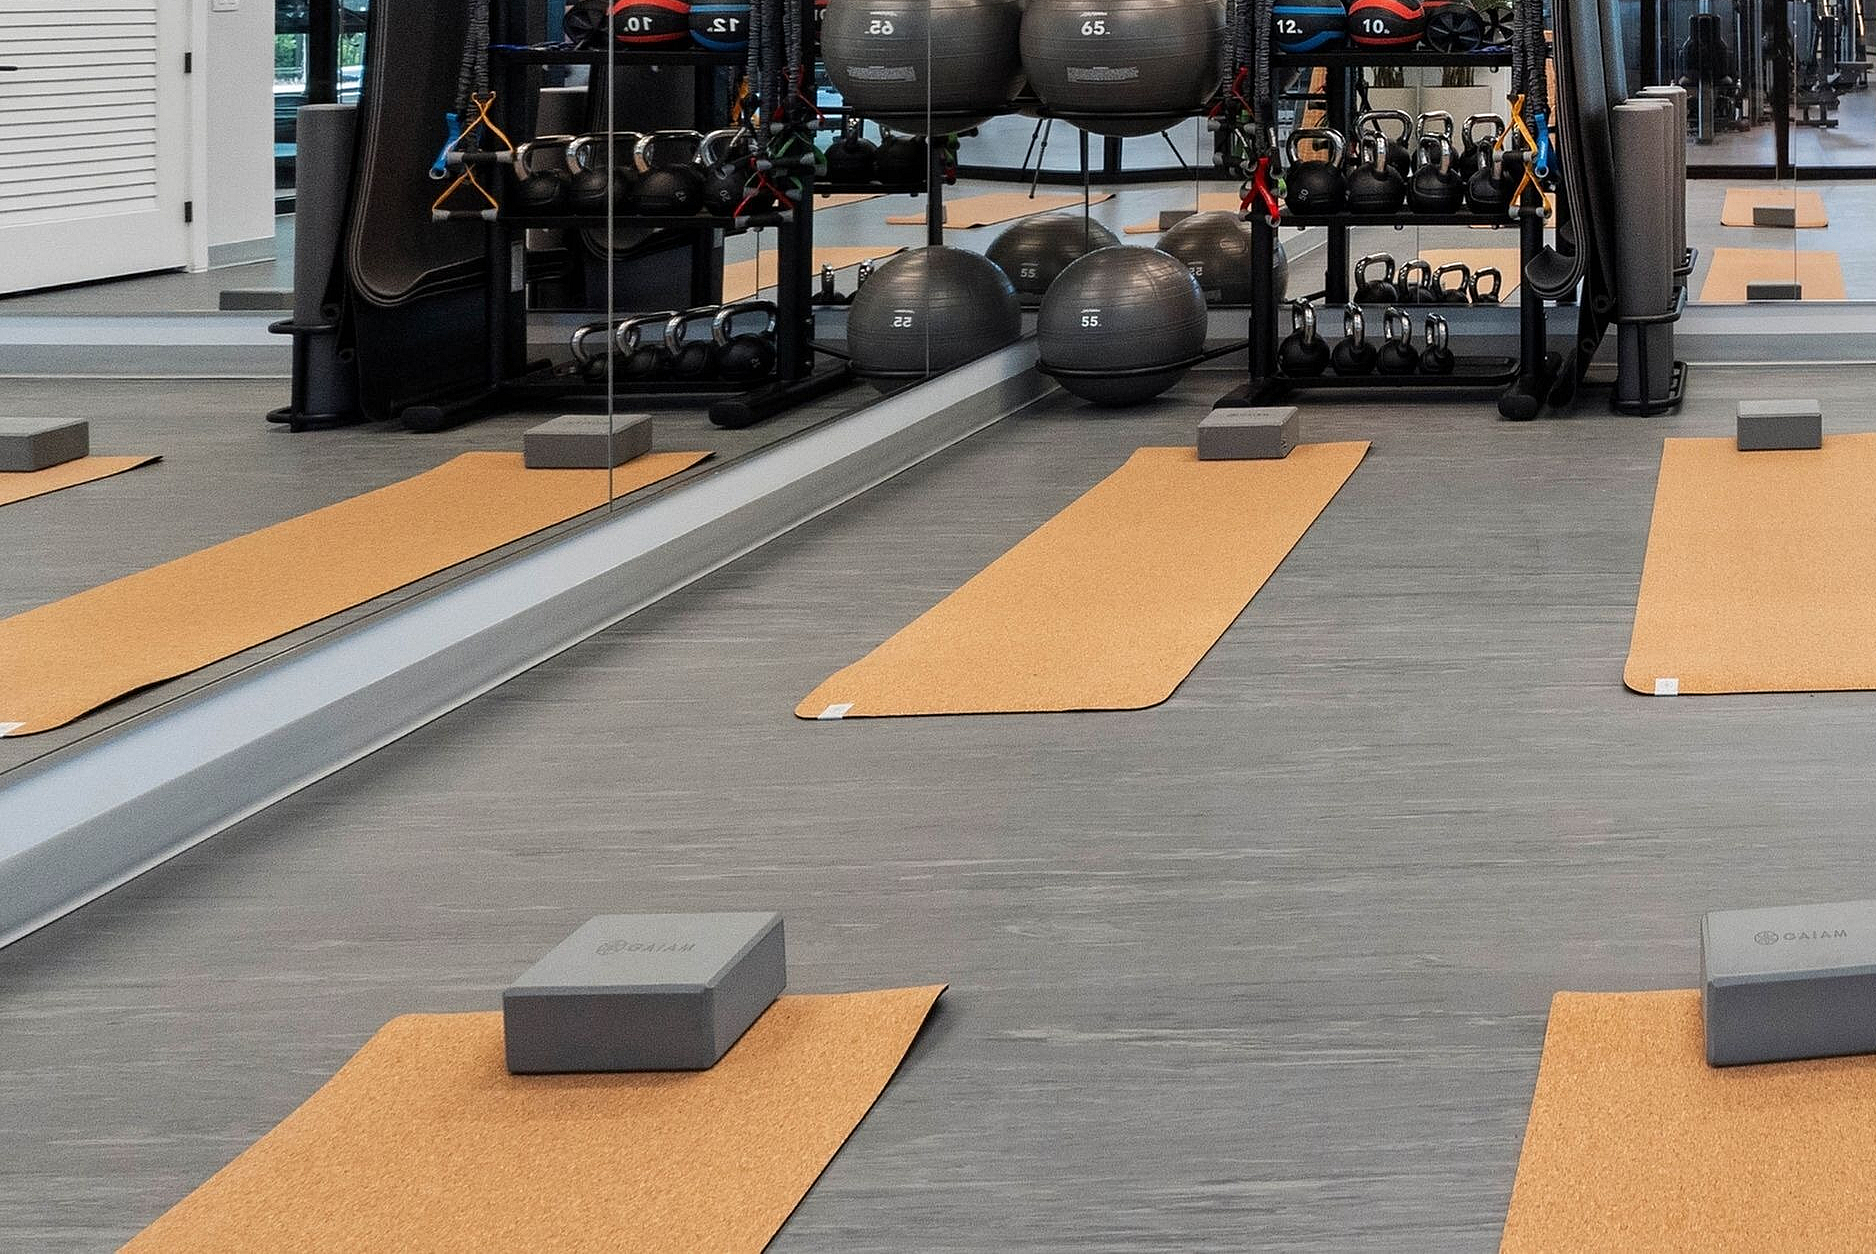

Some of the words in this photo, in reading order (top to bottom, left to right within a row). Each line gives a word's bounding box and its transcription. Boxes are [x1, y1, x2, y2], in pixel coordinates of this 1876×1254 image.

[1080, 20, 1106, 36] 65
[1276, 19, 1298, 35] 12
[1362, 18, 1385, 35] 10
[1081, 315, 1098, 327] 55
